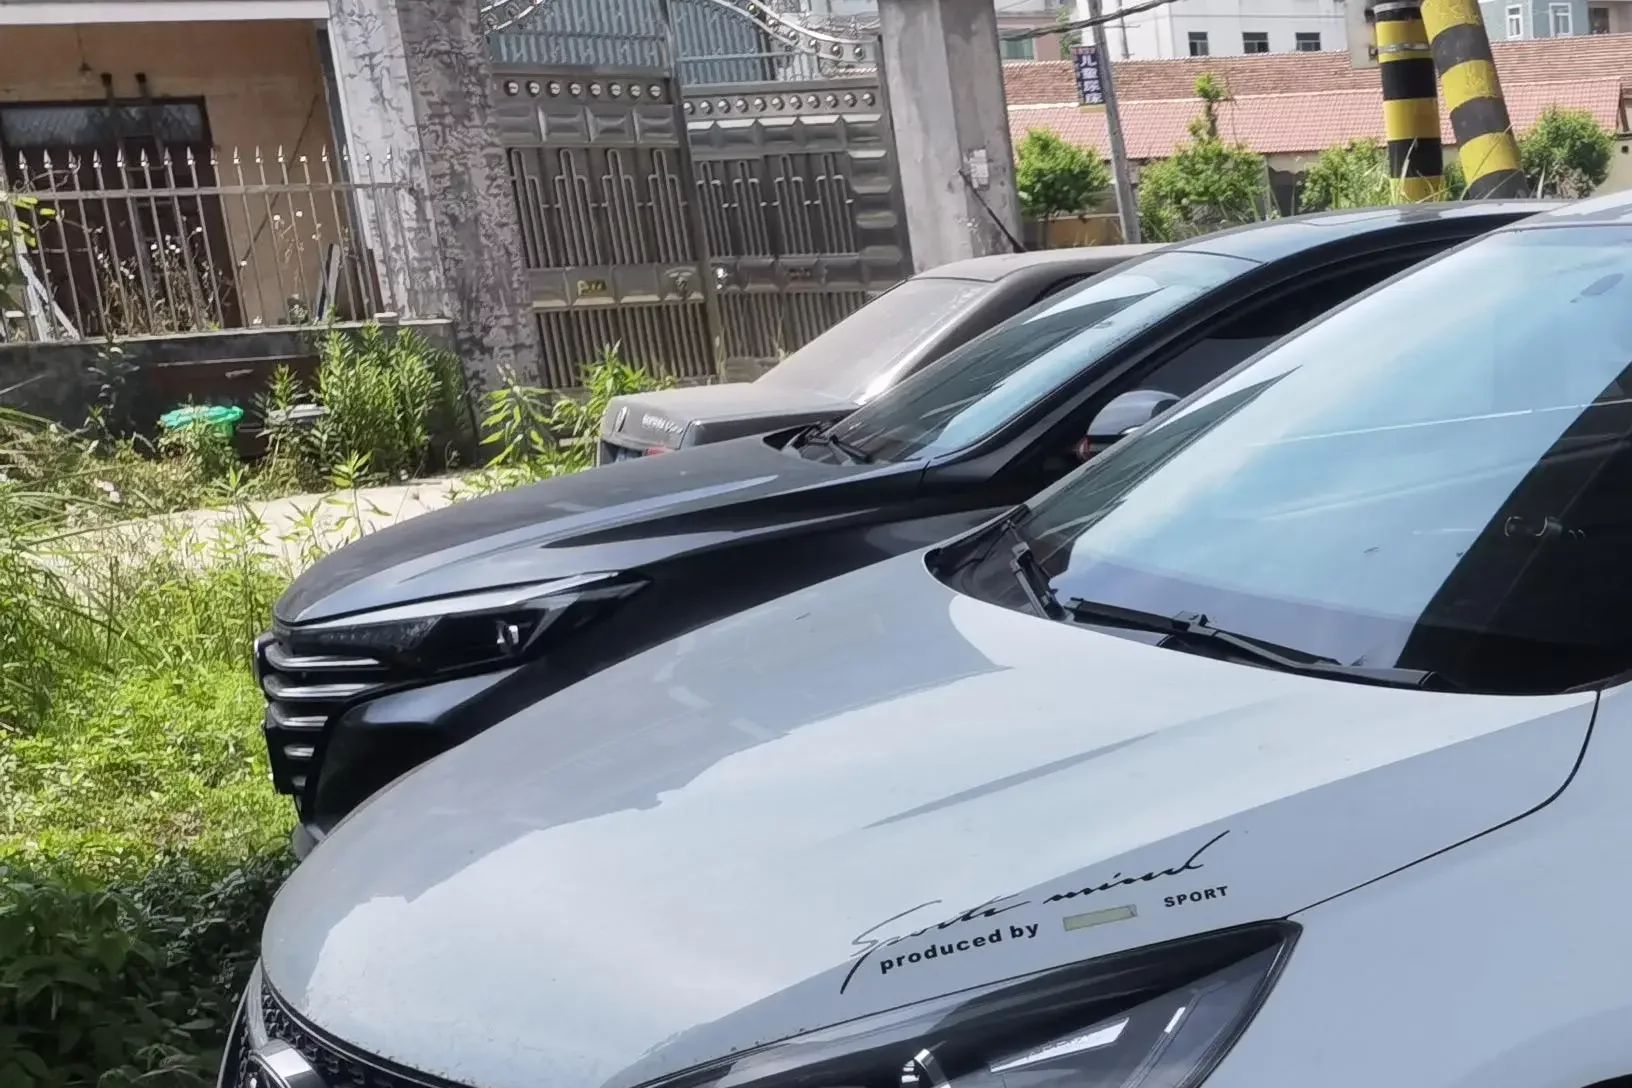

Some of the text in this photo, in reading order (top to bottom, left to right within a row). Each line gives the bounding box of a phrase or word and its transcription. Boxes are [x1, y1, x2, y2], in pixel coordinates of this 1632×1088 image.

[879, 884, 1229, 974] produced by SPORT
